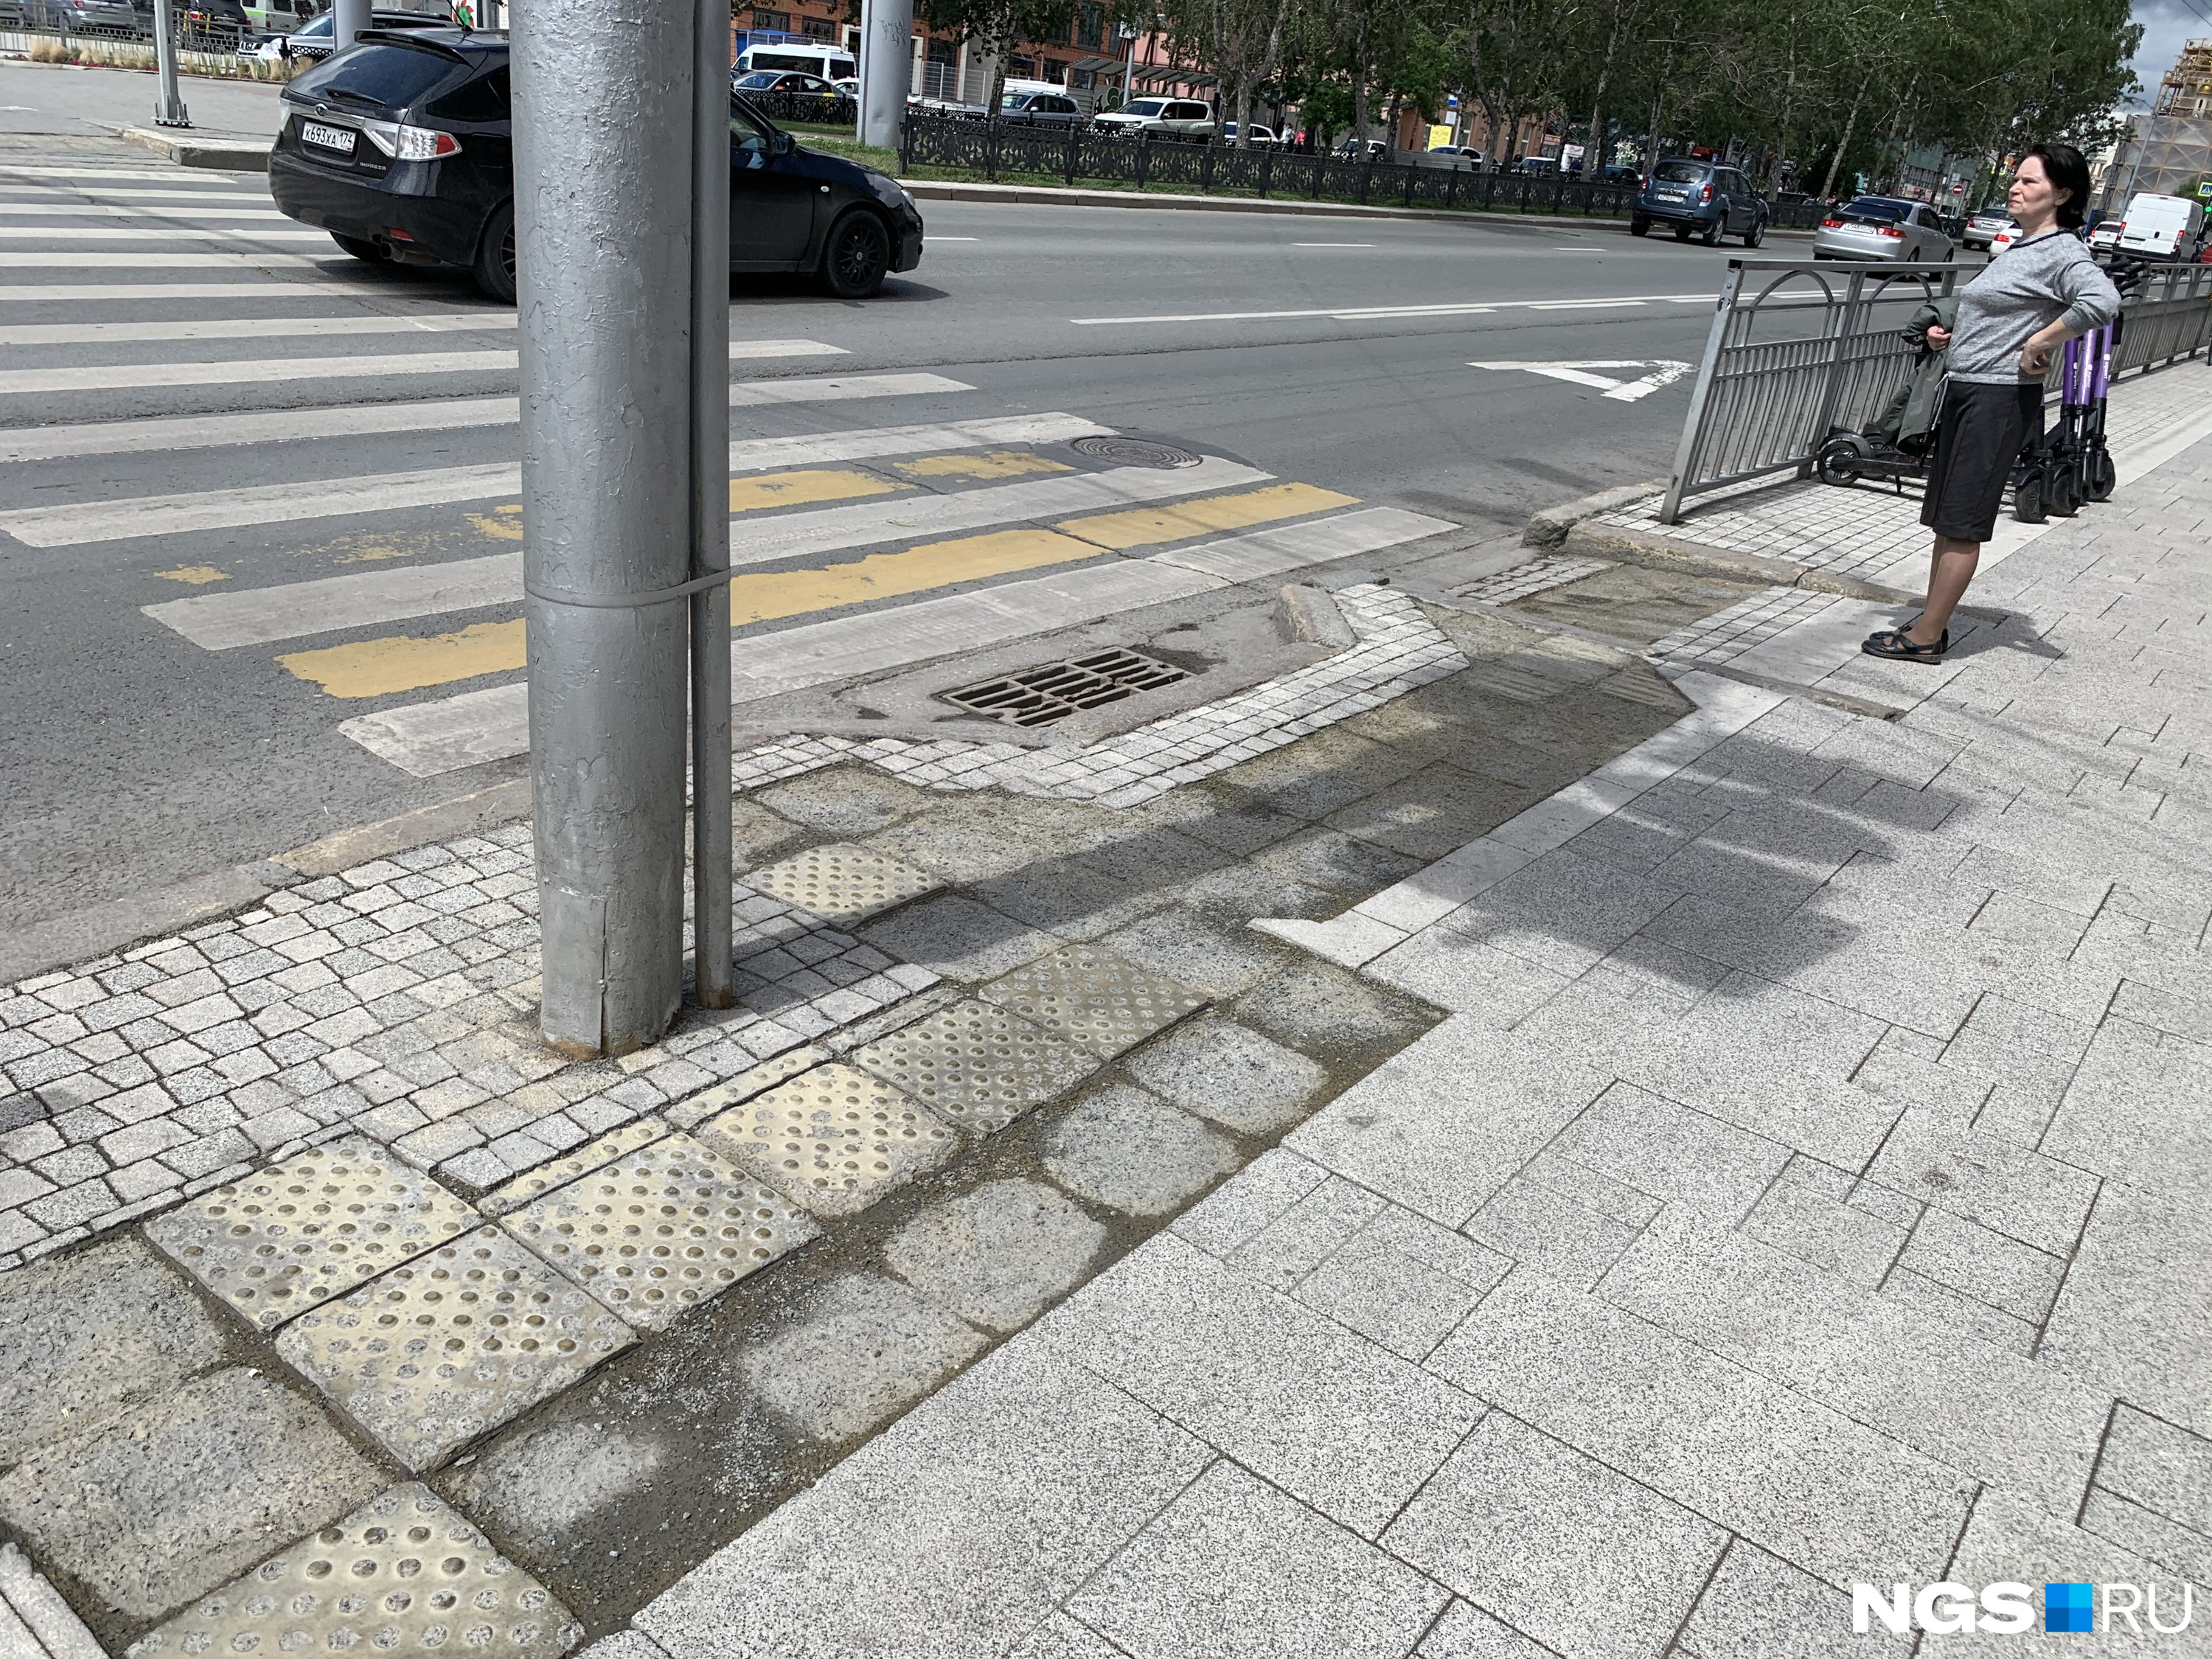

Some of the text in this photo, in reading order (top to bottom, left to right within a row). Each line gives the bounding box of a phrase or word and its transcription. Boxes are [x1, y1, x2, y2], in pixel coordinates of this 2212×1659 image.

[305, 126, 352, 147] К693ХА 174
[360, 162, 386, 170] IMPREZA
